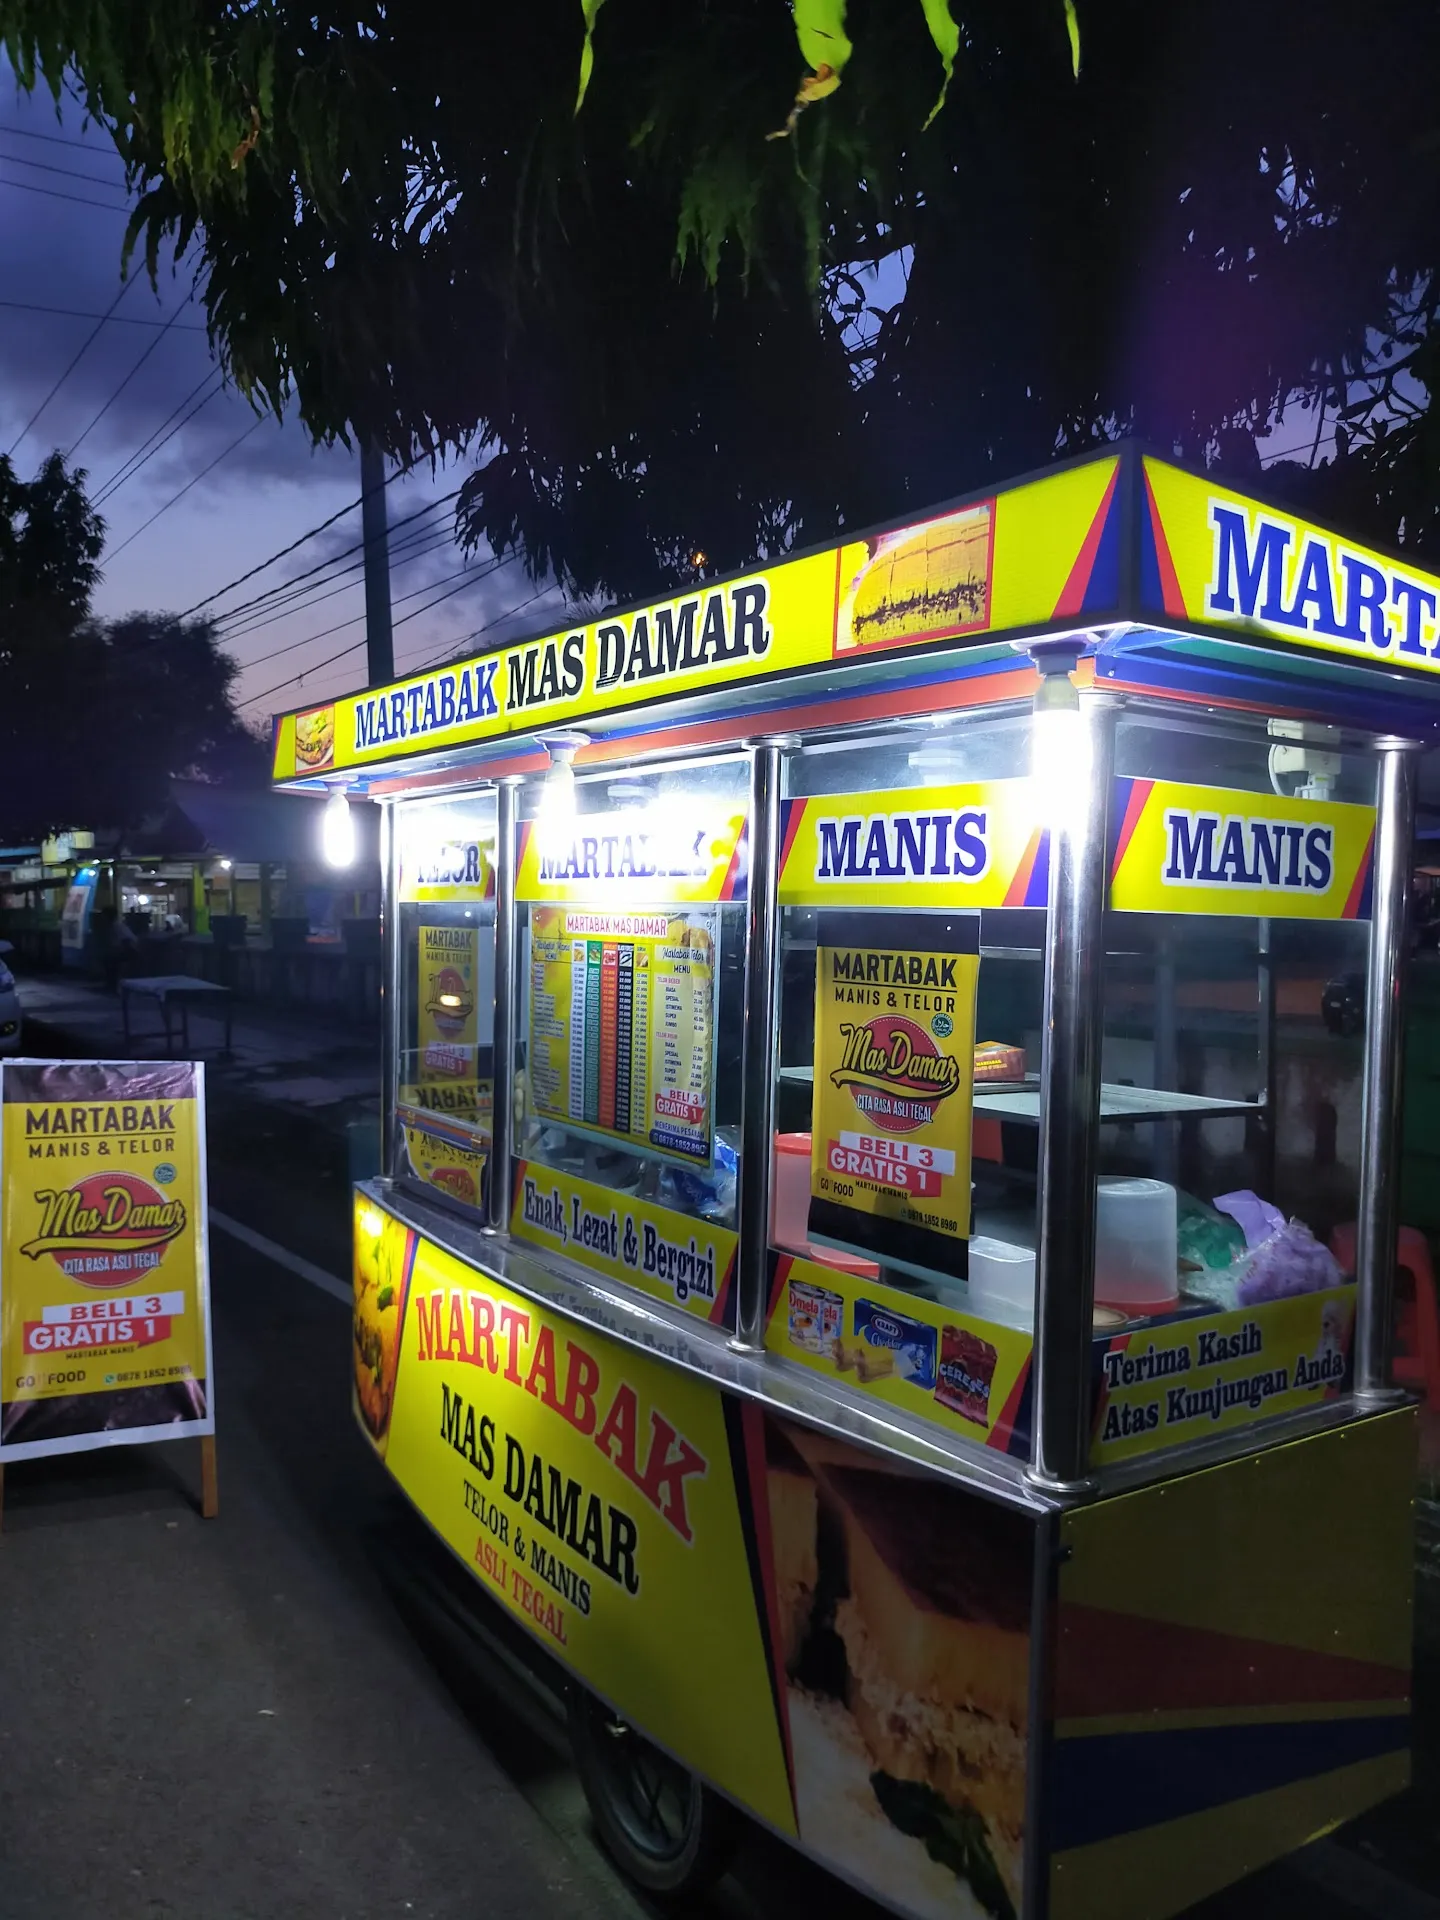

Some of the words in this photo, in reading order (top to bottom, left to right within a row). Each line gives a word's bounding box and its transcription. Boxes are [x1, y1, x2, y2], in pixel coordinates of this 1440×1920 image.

[1210, 506, 1440, 660] MART
[354, 661, 500, 749] MARTABAK
[506, 633, 586, 709] MAS
[596, 582, 770, 689] DAMAR
[817, 812, 988, 878] MANIS
[1165, 814, 1333, 889] MANIS
[425, 929, 472, 949] MARTABAK
[567, 915, 610, 932] MARTABAK
[613, 917, 632, 934] MAS
[634, 917, 667, 936] DAMAR
[673, 964, 691, 974] MENU
[833, 951, 958, 988] MARTABAK
[835, 987, 880, 1006] MANIS
[886, 991, 897, 1007] &
[903, 993, 955, 1013] TELOR
[426, 1052, 455, 1070] GRATIS
[840, 1023, 888, 1072] Mas
[886, 1030, 959, 1083] Damar
[657, 1098, 688, 1118] GRATIS
[692, 1108, 696, 1119] 1
[670, 1089, 690, 1102] BELI
[692, 1094, 698, 1105] 3
[857, 1094, 873, 1110] CITA
[874, 1098, 892, 1115] RASA
[893, 1101, 909, 1118] ASLI
[910, 1104, 933, 1123] TEGAL
[25, 1104, 175, 1135] MARTABAK
[28, 1141, 91, 1158] MANIS
[97, 1140, 111, 1155] &
[117, 1138, 175, 1154] TELOR
[859, 1136, 909, 1162] BELI
[918, 1148, 934, 1167] 3
[830, 1147, 908, 1186] GRATIS
[917, 1171, 927, 1190] 1
[820, 1177, 829, 1191] GO
[833, 1182, 854, 1198] FOOD
[34, 1188, 101, 1238] Mas
[99, 1185, 186, 1233] Damar
[924, 1212, 940, 1227] 1852
[524, 1179, 568, 1242] Enak,
[571, 1197, 618, 1258] Lezat
[623, 1217, 639, 1266] &
[643, 1222, 714, 1300] Bergizi
[63, 1257, 84, 1275] CITA
[85, 1256, 110, 1272] RASA
[112, 1254, 132, 1270] ASLI
[134, 1252, 161, 1268] TEGAL
[70, 1300, 133, 1320] BELI
[145, 1296, 162, 1314] 3
[29, 1321, 134, 1350] GRATIS
[144, 1319, 155, 1338] 1
[876, 1318, 898, 1335] KRAFT
[1105, 1346, 1191, 1389] Terima
[1197, 1323, 1263, 1367] Kasih
[16, 1375, 36, 1389] GO
[47, 1370, 86, 1385] FOOD
[143, 1369, 165, 1380] 1852
[1102, 1404, 1159, 1442] Atas
[1166, 1367, 1289, 1424] Kunjungan
[1292, 1350, 1343, 1390] Anda
[415, 1292, 708, 1543] MARTABAK
[440, 1381, 496, 1481] MAS
[503, 1432, 640, 1595] DAMAR
[463, 1478, 510, 1547] TELOR
[514, 1527, 527, 1562] &
[531, 1541, 592, 1616] MANIS
[474, 1535, 507, 1588] ASLI
[511, 1570, 568, 1646] TEGAL
